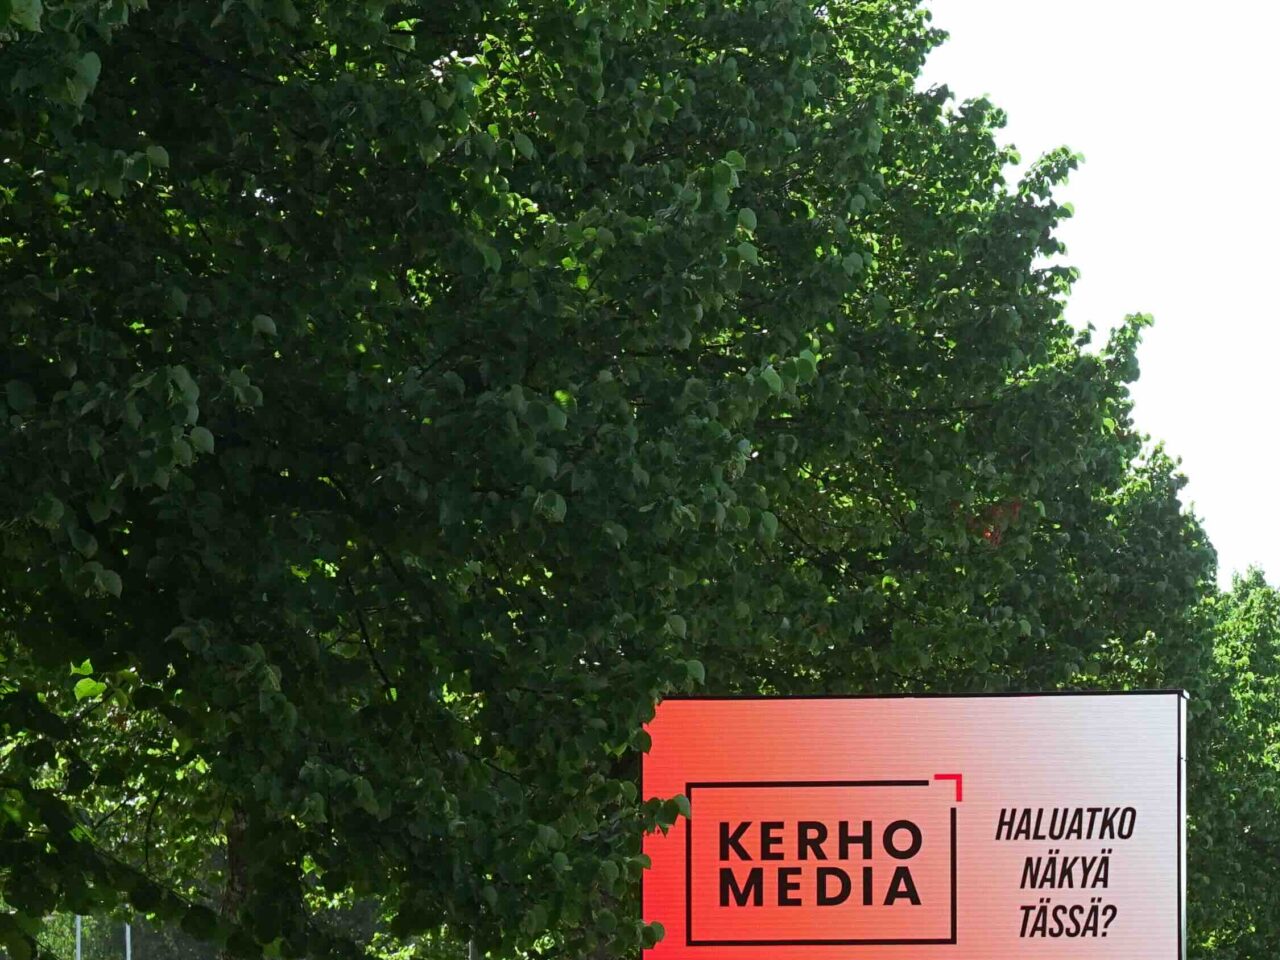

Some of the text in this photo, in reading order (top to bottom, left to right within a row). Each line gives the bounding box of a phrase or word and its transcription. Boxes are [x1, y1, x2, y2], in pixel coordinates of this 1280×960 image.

[719, 819, 922, 861] KERHO
[995, 806, 1137, 840] HALUATKO
[719, 866, 922, 907] MEDIA
[1019, 848, 1112, 889] NÄKYÄ
[1019, 897, 1118, 938] TÄSSÄ?
